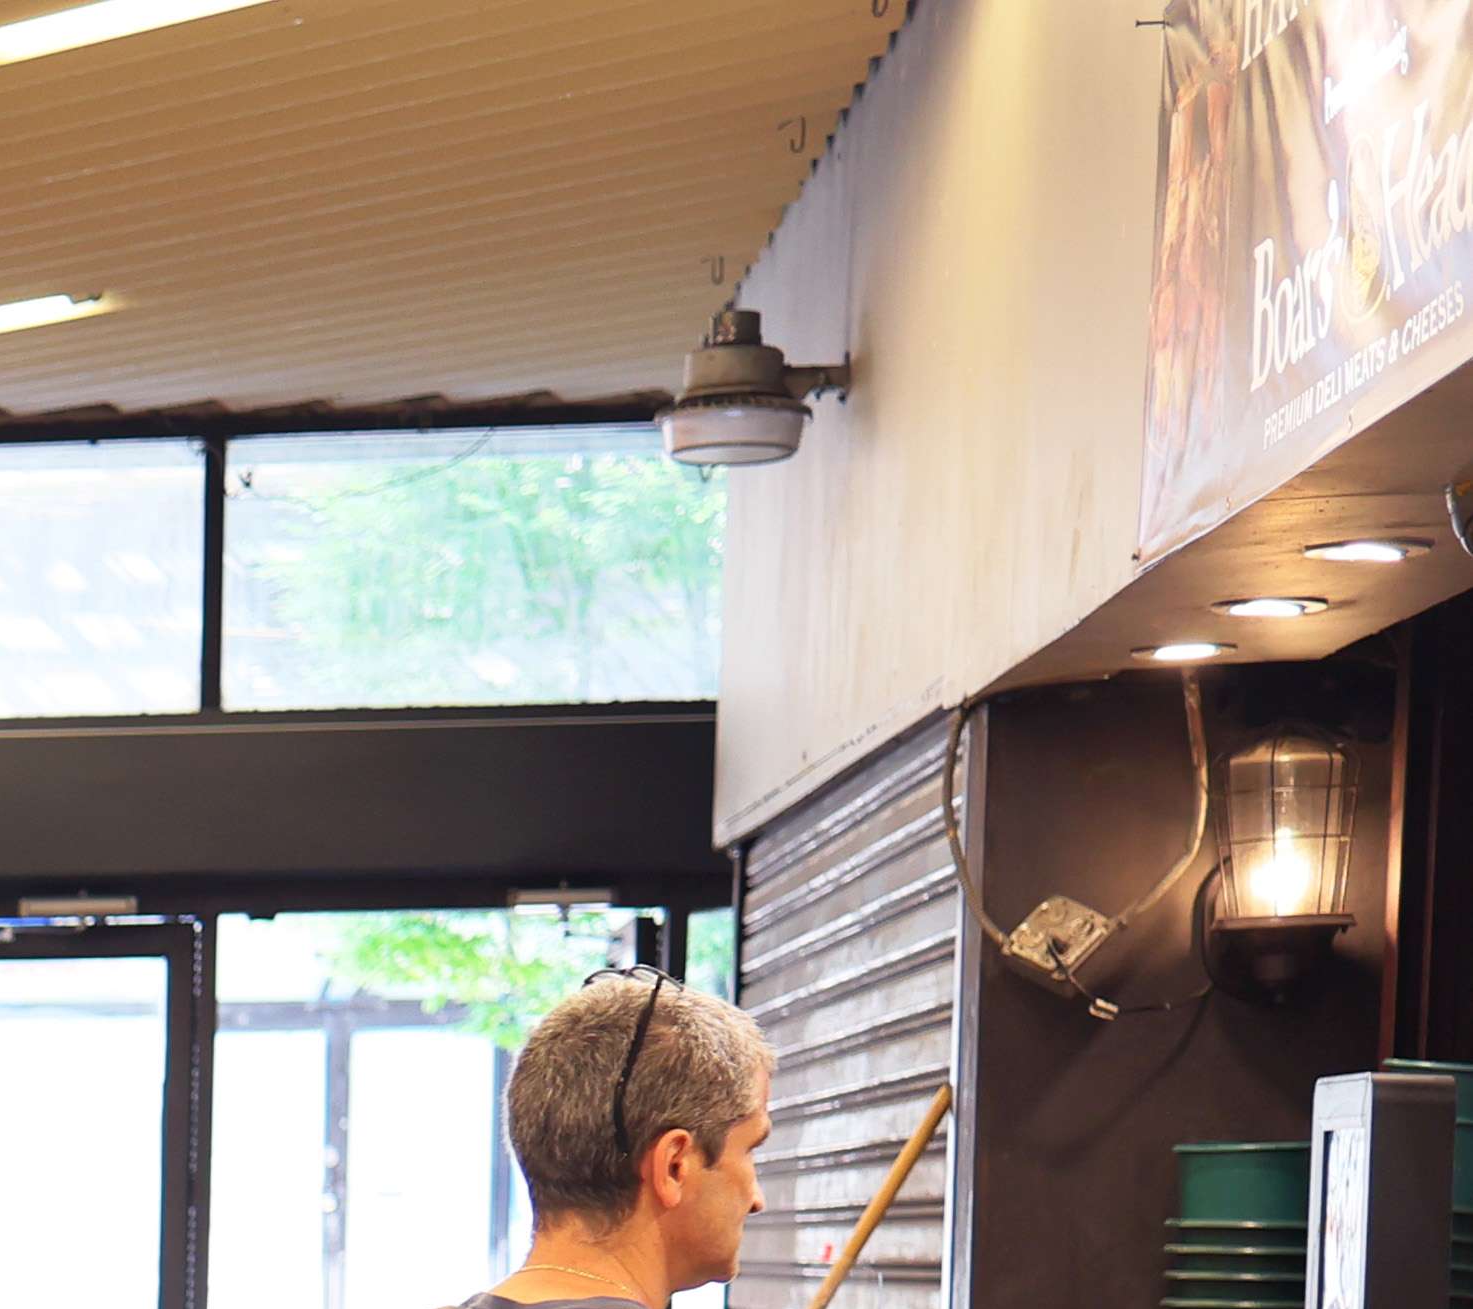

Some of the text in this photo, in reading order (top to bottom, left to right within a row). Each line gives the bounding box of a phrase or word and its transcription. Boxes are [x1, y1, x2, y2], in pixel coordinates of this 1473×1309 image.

[1263, 280, 1465, 450] PREMIUM DELI MEATS & CHEESES
